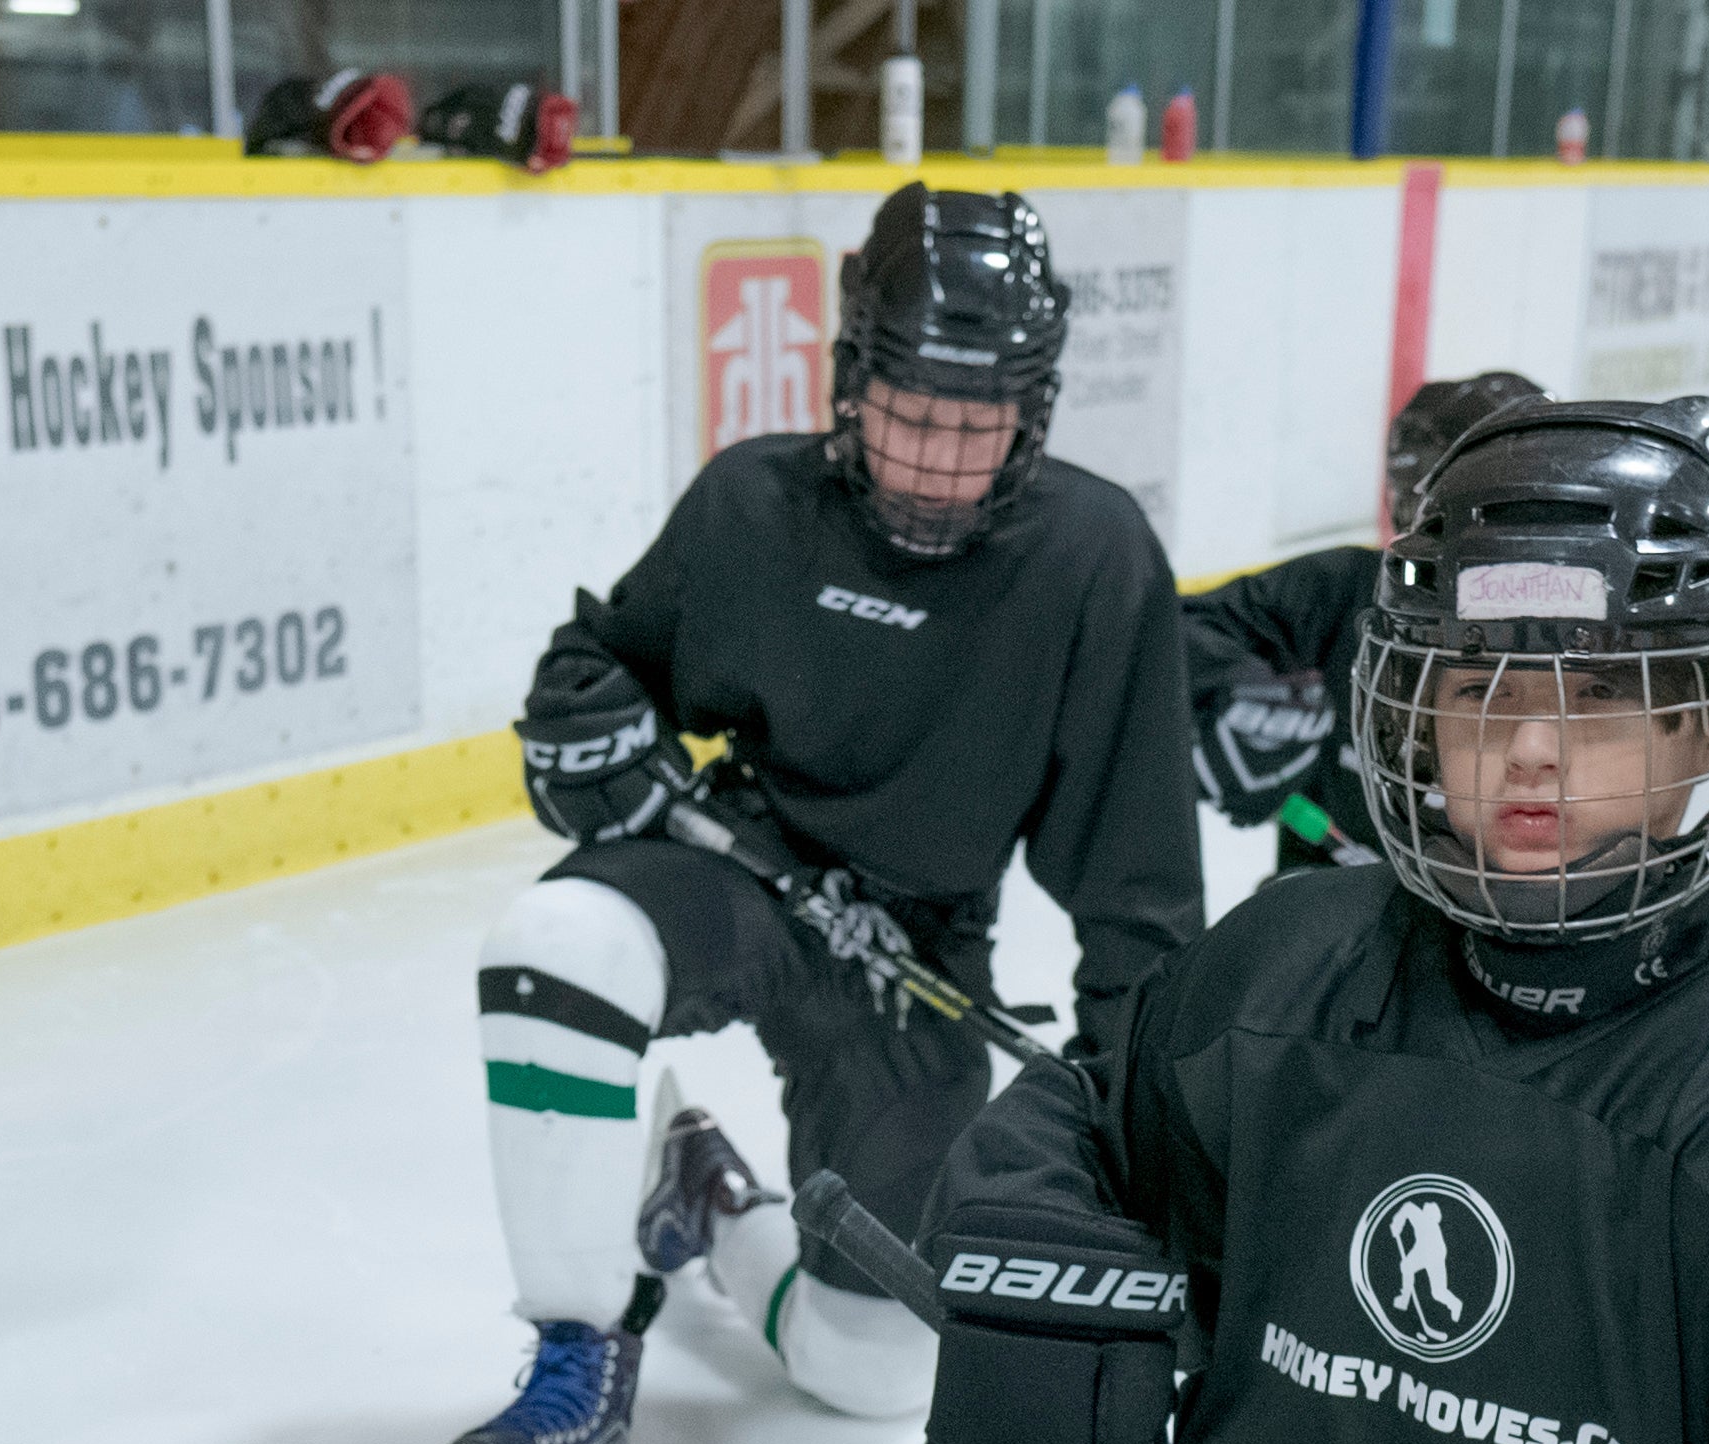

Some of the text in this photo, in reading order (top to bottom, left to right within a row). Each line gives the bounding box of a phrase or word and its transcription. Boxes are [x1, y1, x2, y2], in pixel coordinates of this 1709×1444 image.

[2, 318, 173, 474] Hockey
[190, 313, 357, 463] Sponsor
[816, 584, 928, 631] CCM
[1469, 568, 1588, 602] JONATHAN
[524, 708, 658, 774] CCM
[1260, 1322, 1394, 1403] HOCKEY
